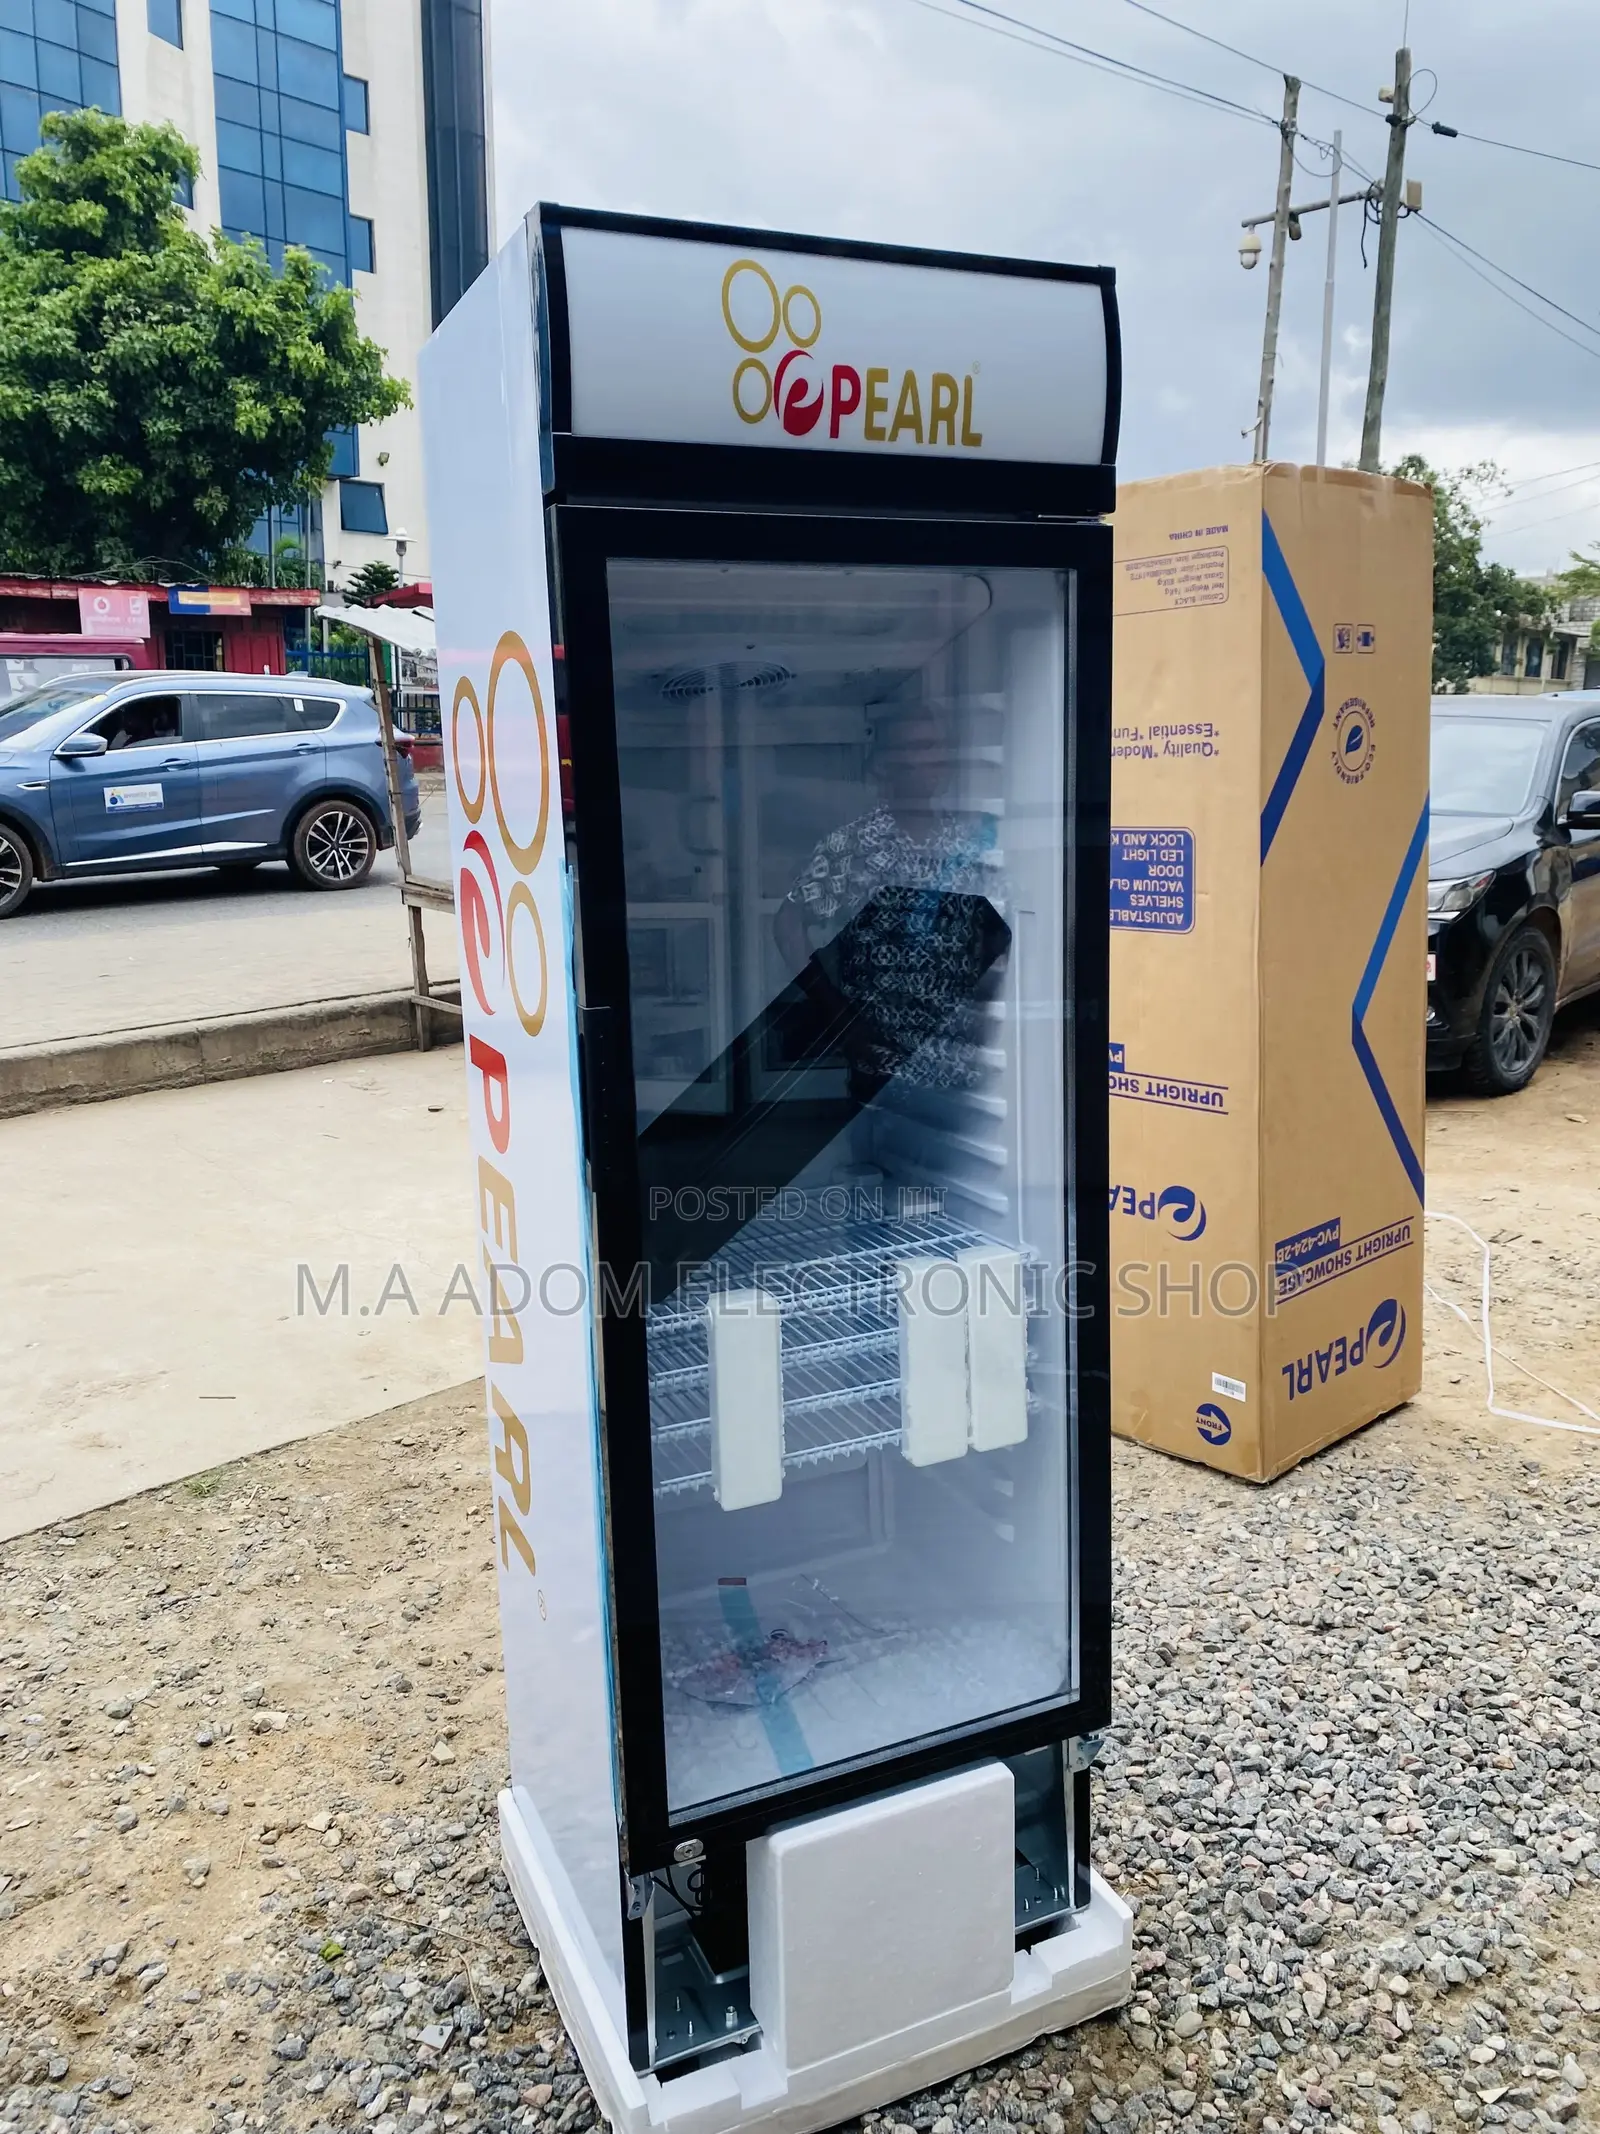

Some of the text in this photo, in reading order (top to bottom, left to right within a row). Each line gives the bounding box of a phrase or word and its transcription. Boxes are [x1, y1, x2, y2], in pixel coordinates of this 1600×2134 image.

[1169, 525, 1228, 540] MADE IN CHINA
[1122, 833, 1147, 845] AND
[1150, 834, 1184, 846] LOCK
[1122, 849, 1184, 862] LED LIGHT
[1148, 865, 1184, 877] DOOR
[1133, 879, 1184, 892] VACUUM
[1130, 894, 1184, 908] SHELVES
[1145, 1081, 1223, 1107] UPRIGHT
[1275, 1224, 1340, 1265] PVC-424-2B
[1278, 1225, 1410, 1296] UPRIGHT SHOWCASE
[1195, 1416, 1223, 1432] FRONT
